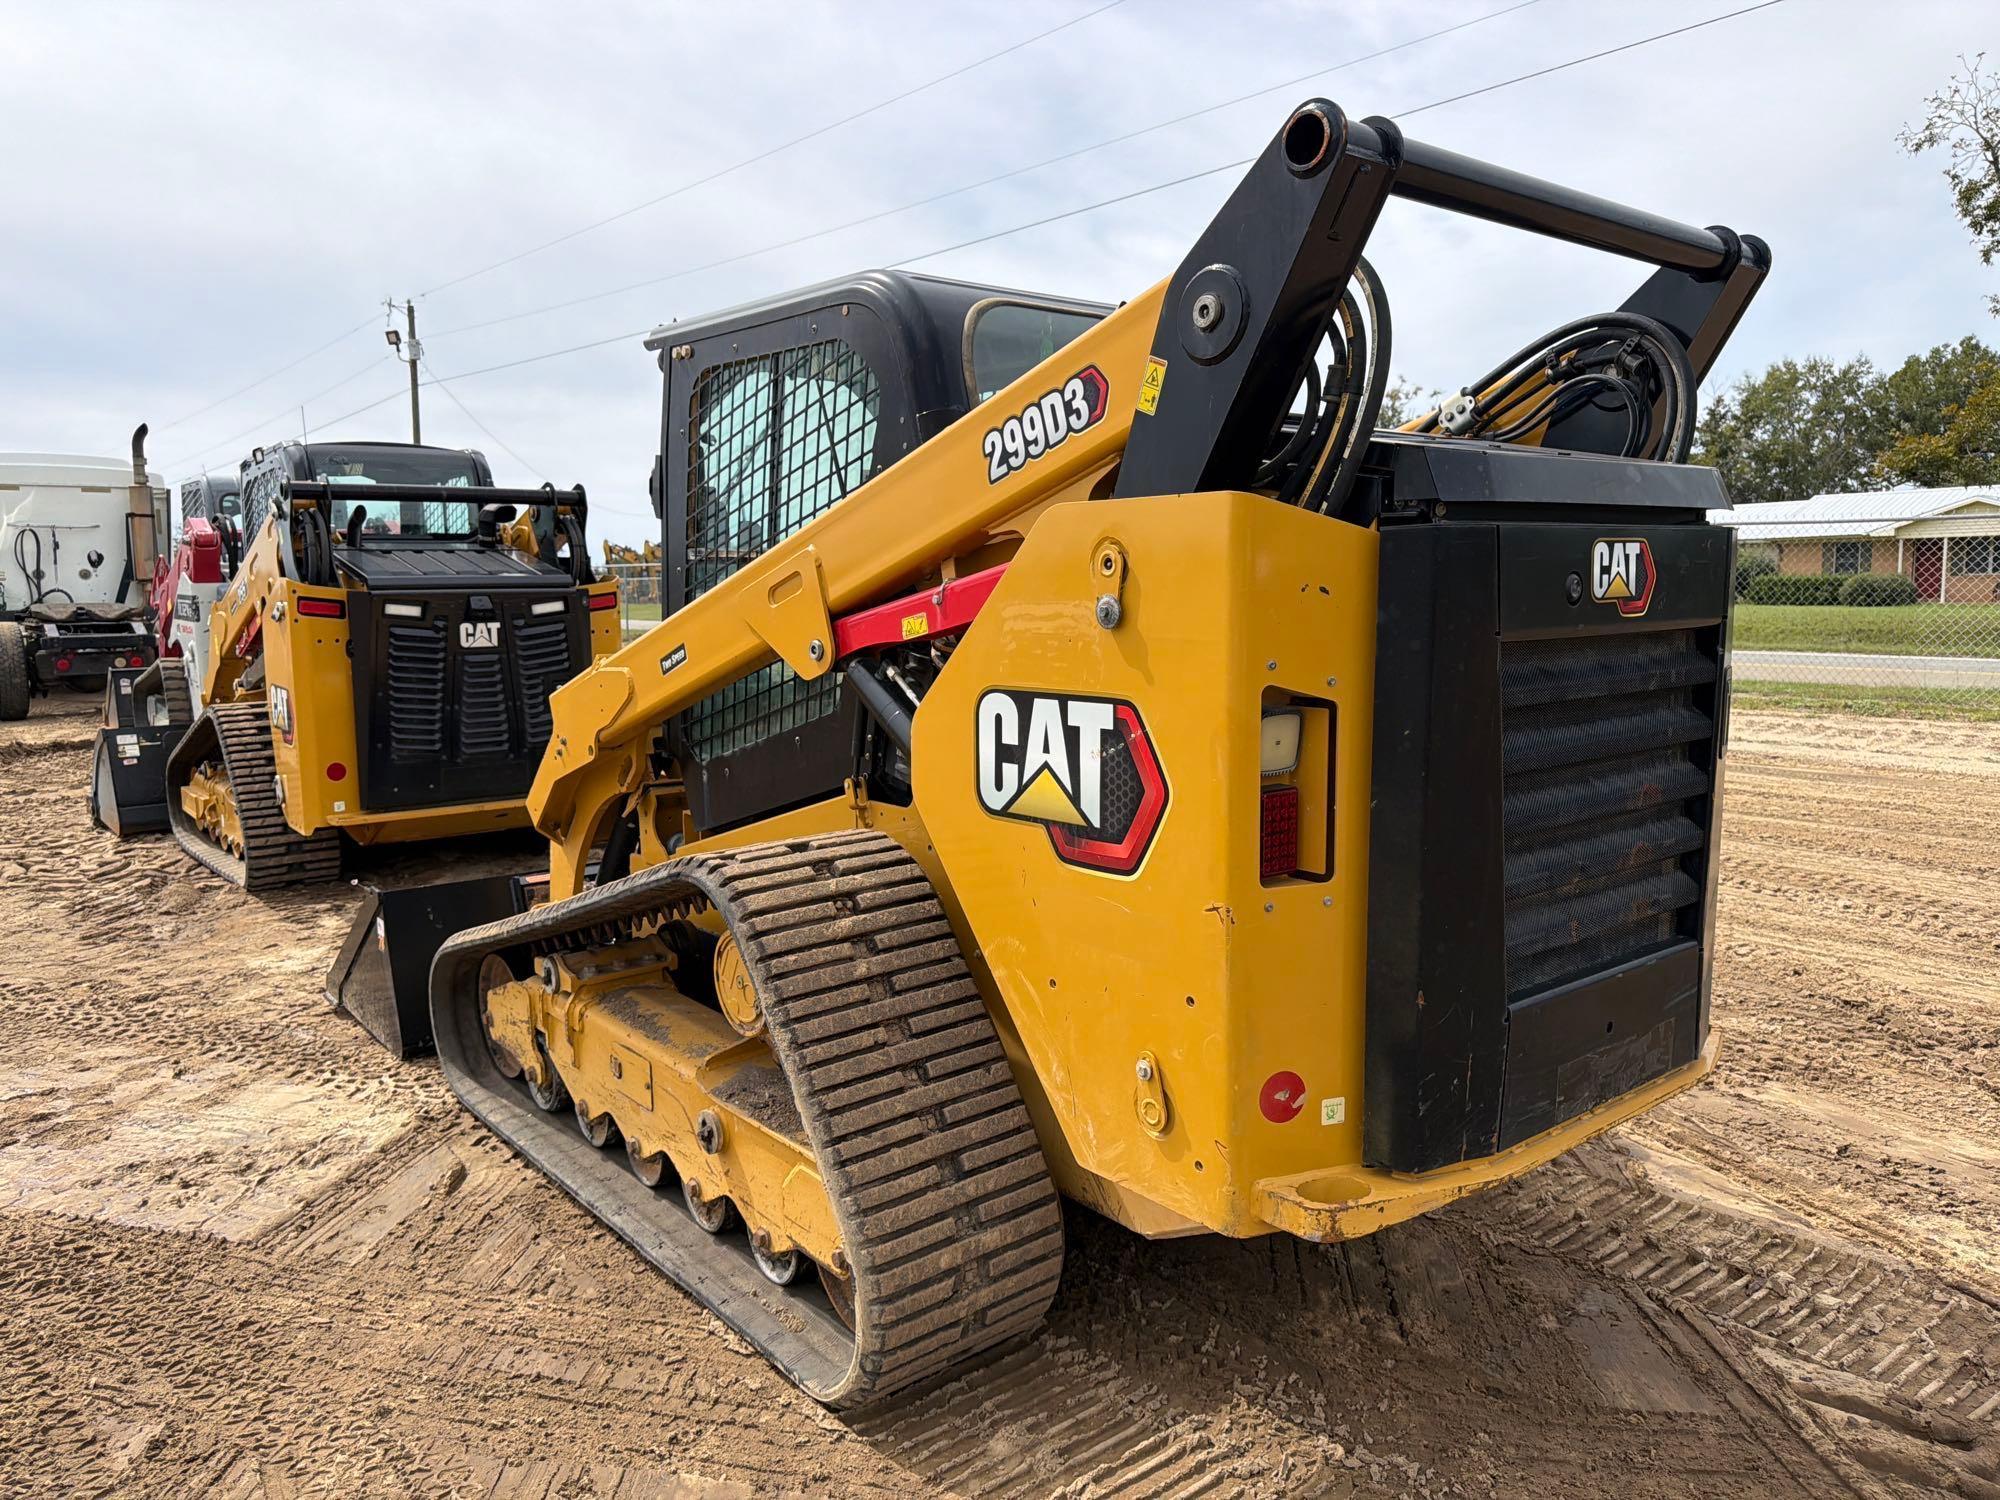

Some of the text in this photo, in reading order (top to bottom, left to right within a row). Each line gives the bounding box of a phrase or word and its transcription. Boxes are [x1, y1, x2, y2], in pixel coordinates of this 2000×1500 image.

[984, 378, 1090, 481] 299D3
[1593, 541, 1640, 599] CAT
[459, 621, 501, 648] CAT
[978, 692, 1114, 829] CAT
